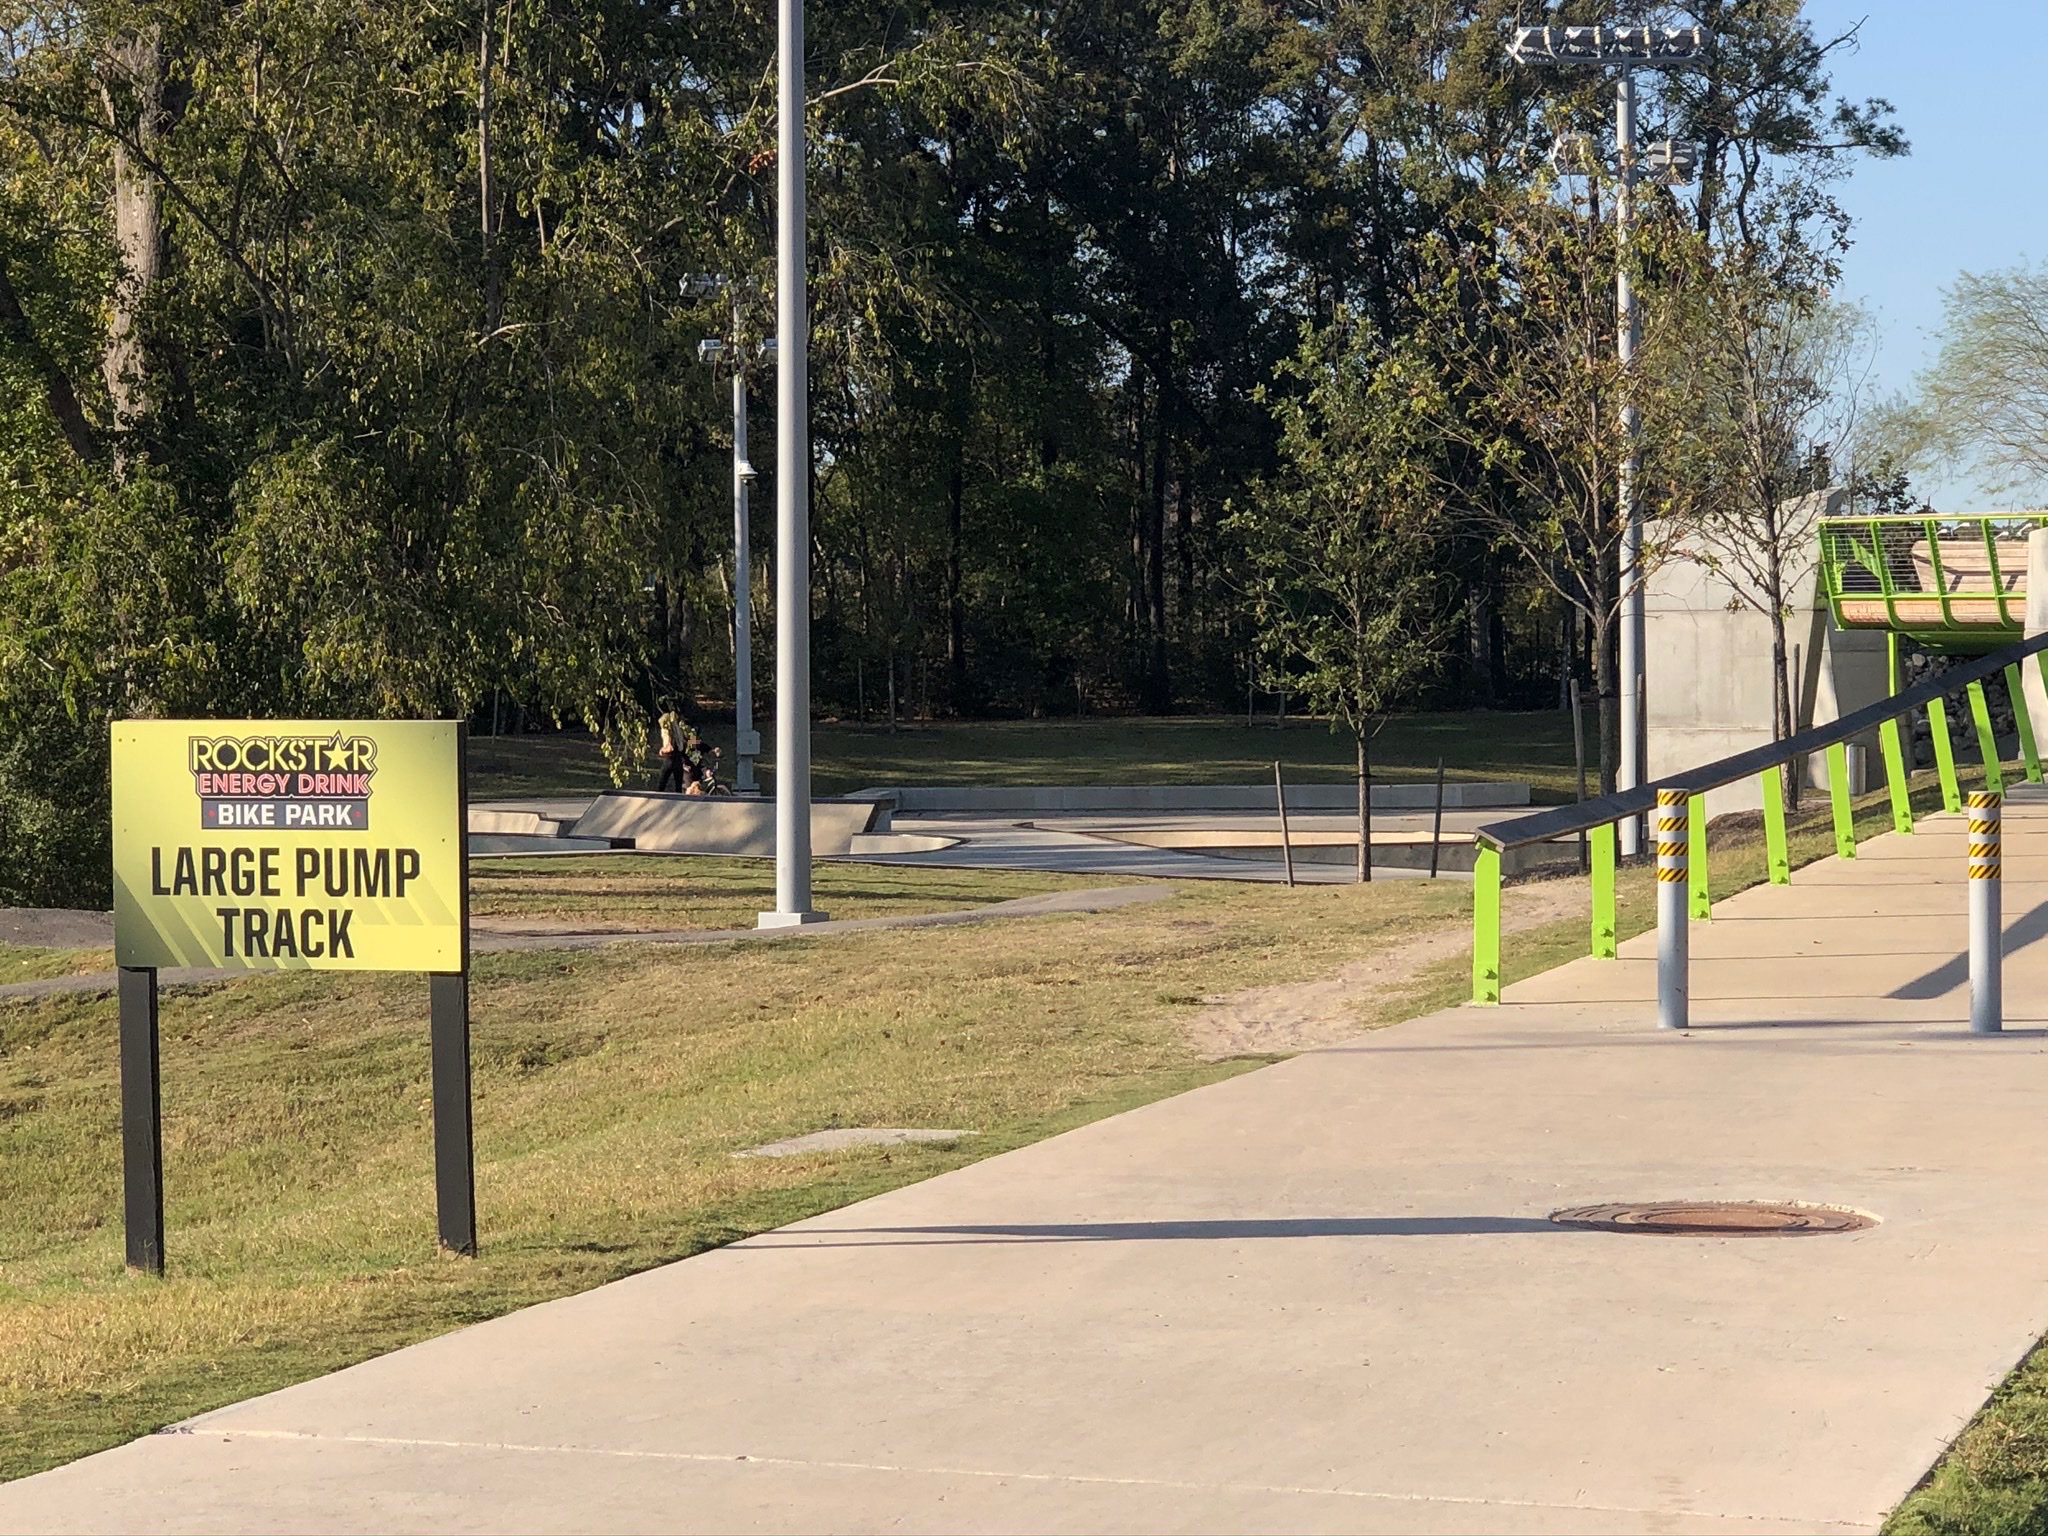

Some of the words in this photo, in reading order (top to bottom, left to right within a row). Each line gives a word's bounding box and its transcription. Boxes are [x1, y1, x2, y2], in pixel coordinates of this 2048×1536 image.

[200, 773, 290, 794] ENERGY
[298, 773, 369, 794] DRINK
[218, 804, 275, 825] BIKE
[285, 804, 352, 825] PARK
[151, 847, 281, 897] LARGE
[295, 847, 420, 898] PUMP
[216, 908, 355, 959] TRACK
